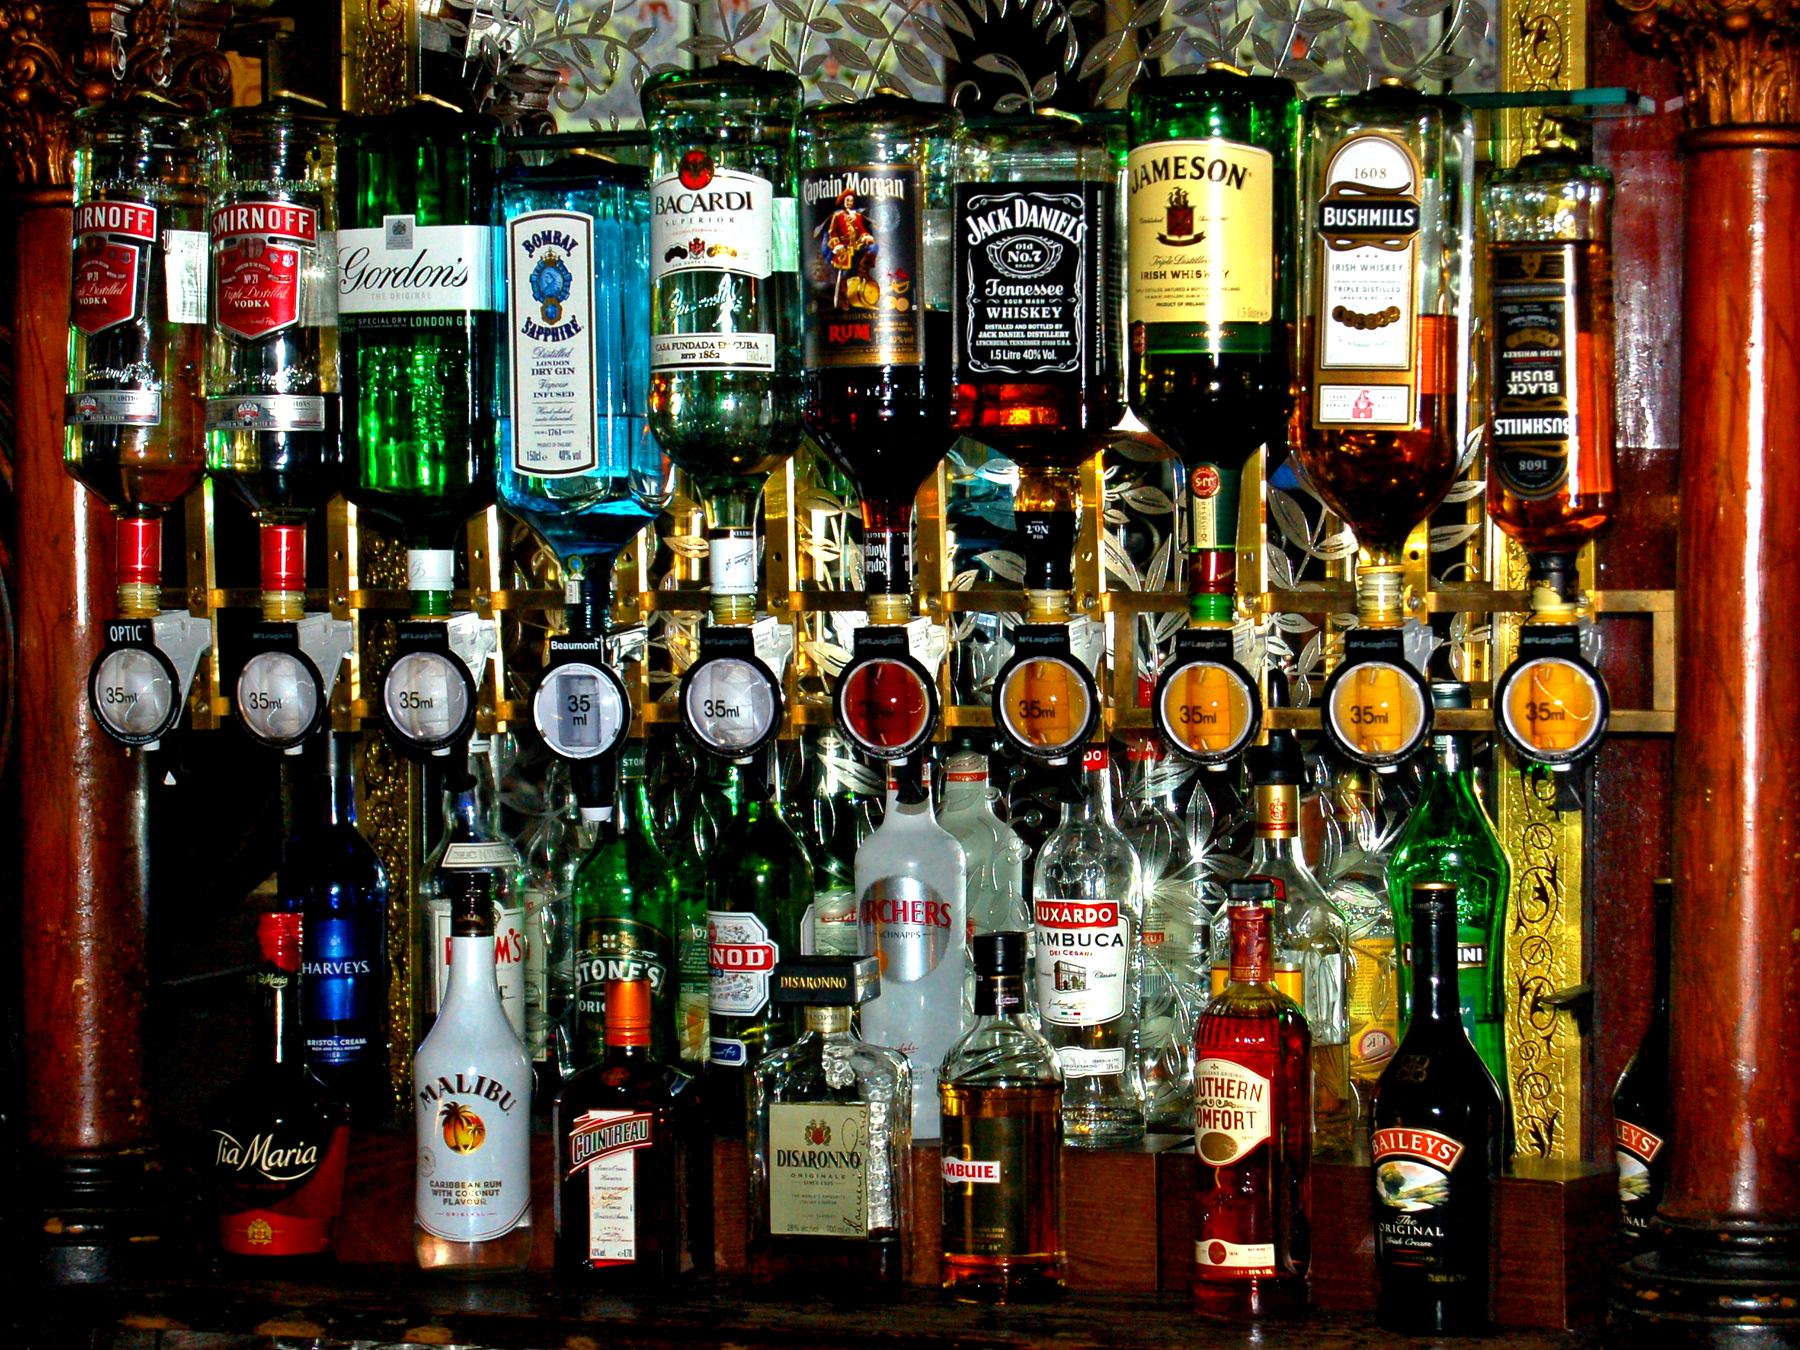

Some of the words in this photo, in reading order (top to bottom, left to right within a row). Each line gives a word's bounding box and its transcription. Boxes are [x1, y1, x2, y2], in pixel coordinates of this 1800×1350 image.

[1131, 156, 1248, 194] JAMESON
[1354, 168, 1387, 179] 1608
[803, 174, 842, 205] Captain
[842, 172, 904, 201] Morgan
[655, 191, 753, 215] BACARDI
[75, 206, 148, 232] IRNOFF
[213, 207, 309, 237] SMIRNOFF
[665, 217, 735, 227] SUPERIOR
[965, 206, 1010, 246] JACK
[1014, 199, 1088, 245] DANIEL'S
[1324, 207, 1415, 226] BUSHMILLS
[522, 230, 579, 258] BOMBAY
[1007, 251, 1042, 262] No.7
[339, 247, 468, 294] Gordon's
[1141, 271, 1167, 280] IRISH
[1171, 270, 1229, 279] WHISY
[985, 279, 1064, 296] Tennessee
[234, 300, 270, 308] VODKA
[986, 307, 1062, 319] WHISKEY
[410, 316, 453, 327] LONDON
[521, 315, 582, 342] SAPPHIRE
[828, 322, 871, 345] RUM
[672, 342, 715, 350] FUNDADA
[990, 349, 1002, 360] 1.5
[1003, 349, 1020, 360] Litre
[1023, 349, 1041, 360] 40%
[1042, 349, 1057, 360] Vol.
[555, 367, 575, 375] GIN
[1510, 370, 1554, 382] BUSH
[1507, 382, 1559, 395] BLACK
[1494, 417, 1570, 435] BUSHMILLS
[1519, 459, 1548, 471] 1608
[110, 624, 143, 642] OPTIC
[551, 641, 599, 650] Beaumont
[106, 687, 138, 703] 35ml
[249, 693, 282, 710] 35ml
[399, 692, 433, 709] 35ml
[567, 696, 590, 712] 35
[704, 700, 739, 718] 35ml
[1019, 701, 1055, 719] 35ml
[1180, 705, 1217, 725] 35ml
[1351, 705, 1388, 724] 35ml
[1525, 702, 1565, 721] 35ml
[573, 714, 587, 726] ml
[1036, 905, 1112, 923] LUXARDO
[709, 948, 765, 966] NOD
[302, 960, 370, 975] HARVEYS
[575, 959, 660, 988] STONE'S
[780, 975, 847, 990] DISARONNO
[340, 1038, 368, 1046] CREAM
[419, 1074, 517, 1112] MALIBU
[1195, 1077, 1263, 1102] OUTHERN
[1197, 1107, 1257, 1130] OMFORT
[573, 1120, 649, 1164] COINTREAU
[1616, 1122, 1651, 1152] LEYS
[212, 1129, 245, 1167] Tia
[236, 1133, 317, 1172] Maria
[1371, 1133, 1452, 1160] BAILEYS
[777, 1150, 861, 1170] DISARONNO
[944, 1163, 994, 1178] MBUIE
[432, 1189, 452, 1197] WITH
[455, 1189, 500, 1197] COCONUT
[484, 1180, 502, 1188] RUM
[1396, 1214, 1417, 1226] The
[1379, 1222, 1444, 1237] ORIGINAL
